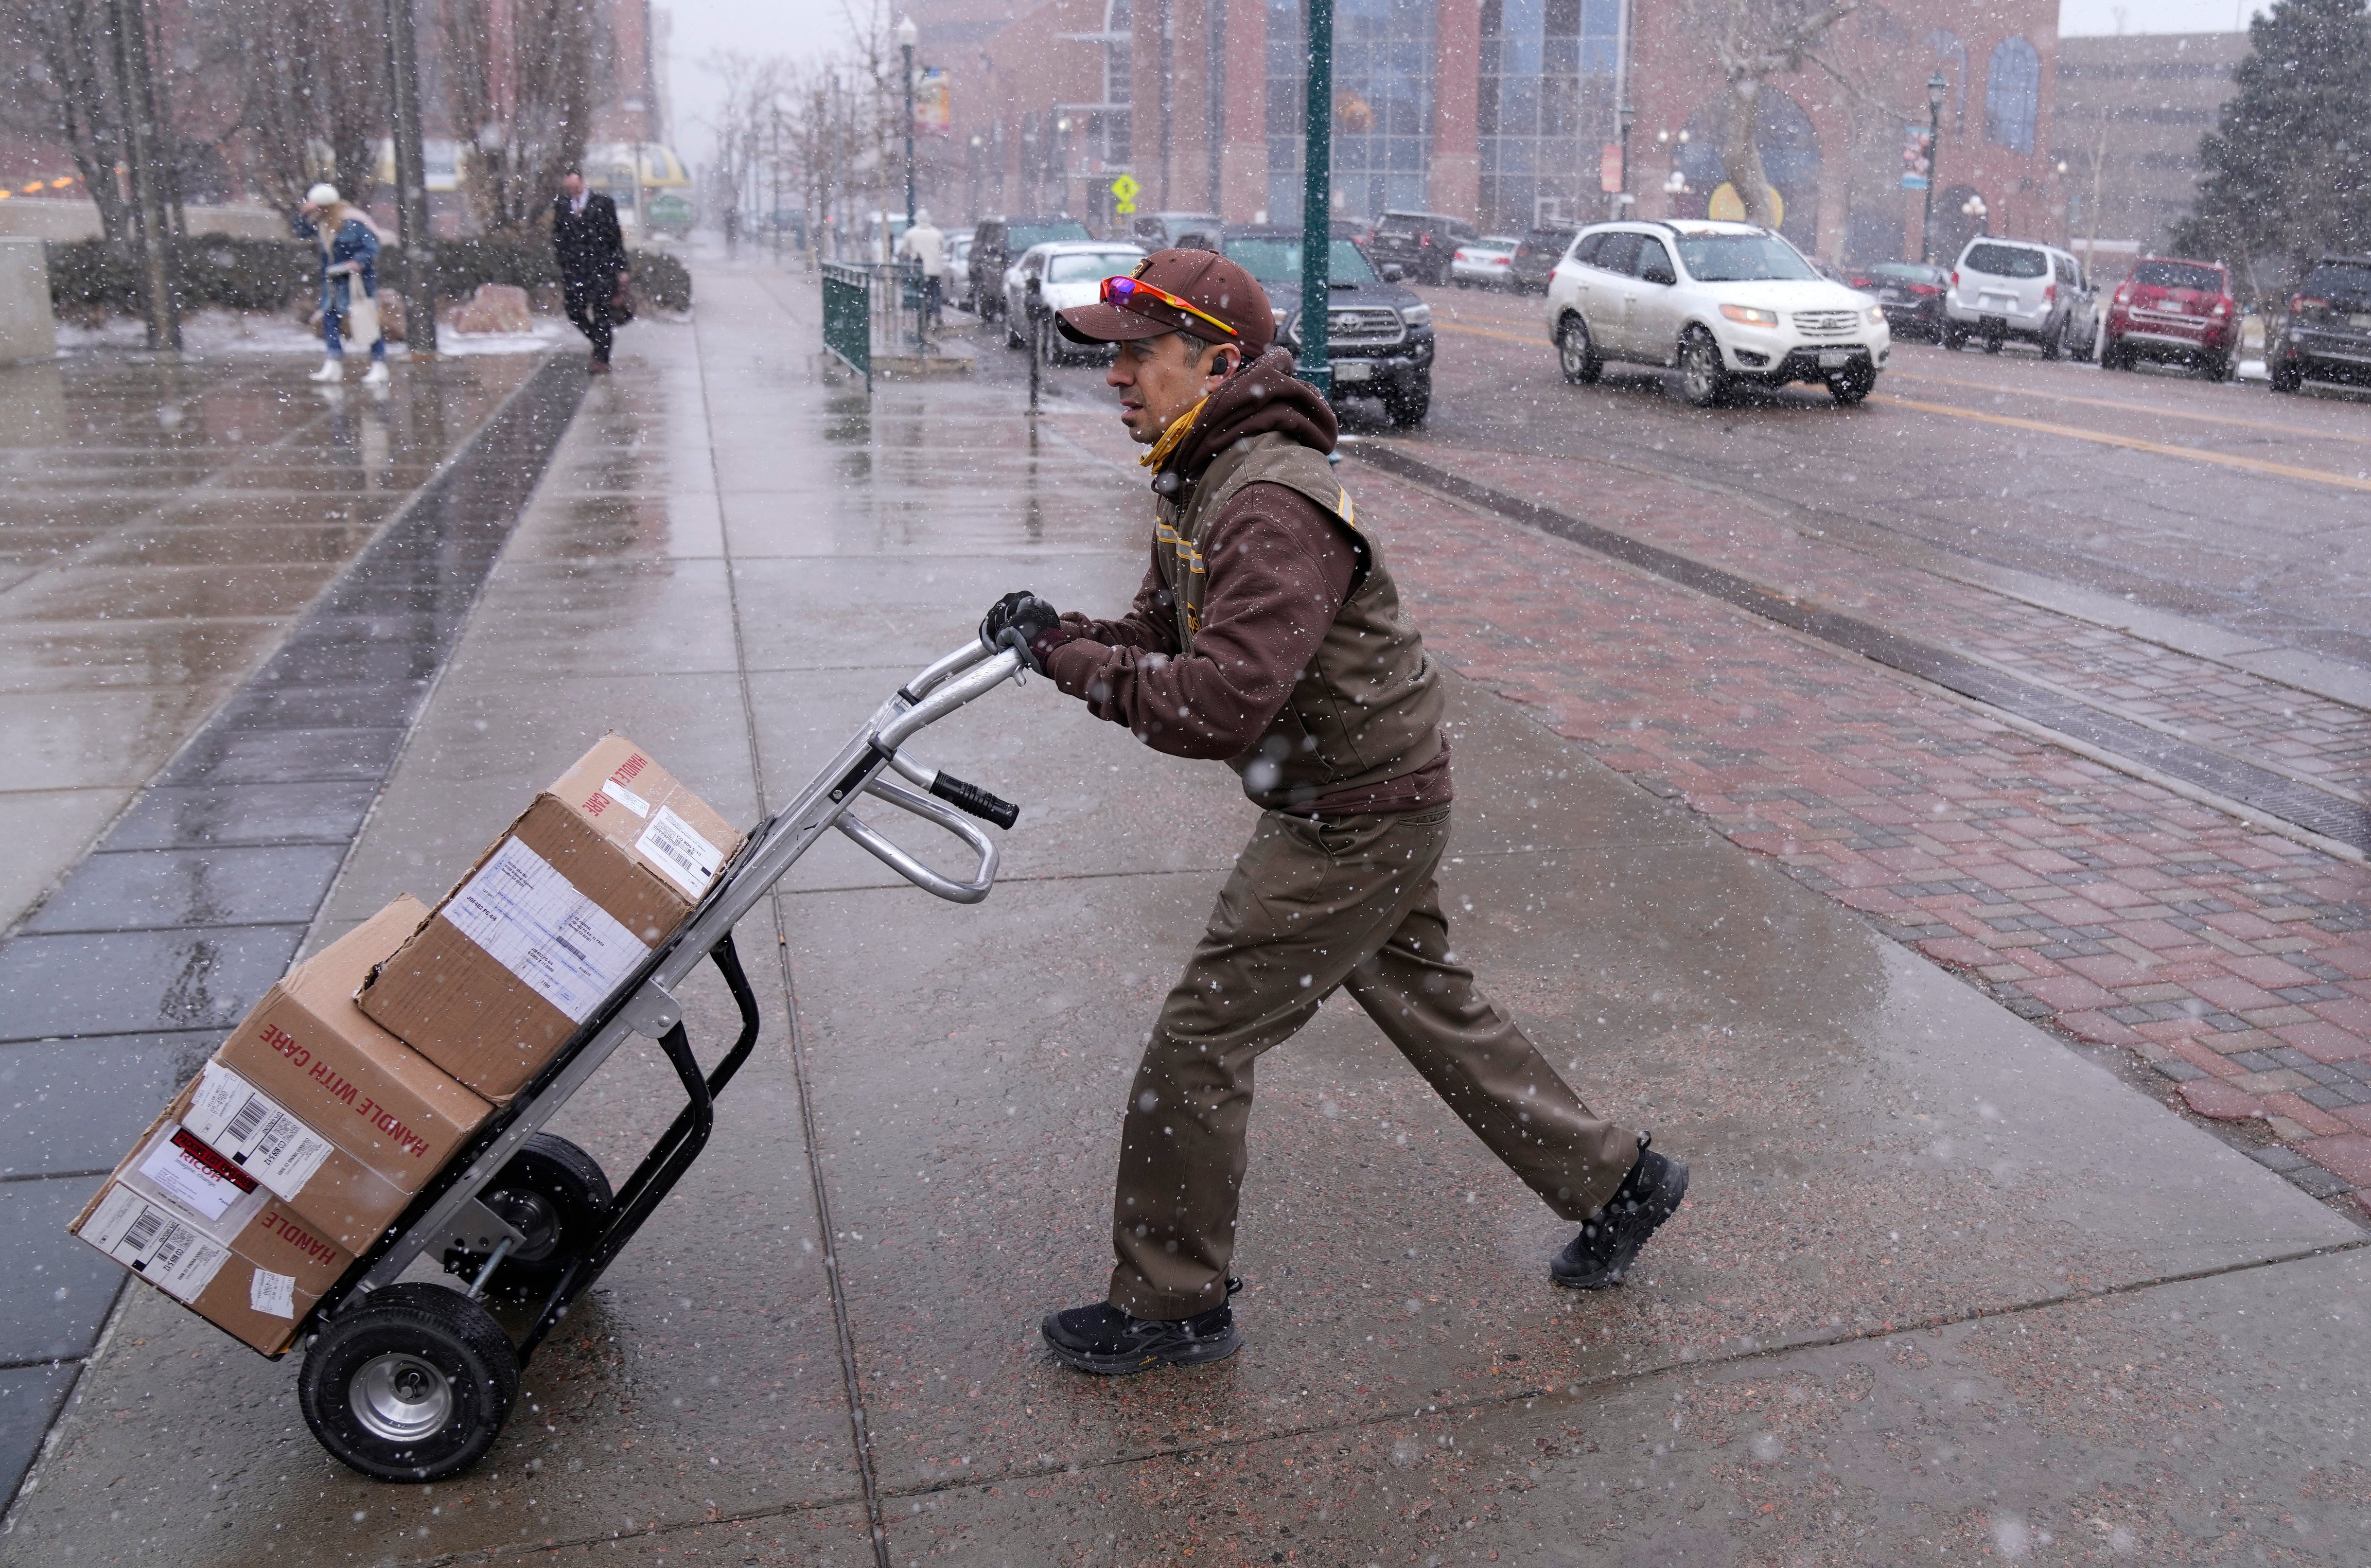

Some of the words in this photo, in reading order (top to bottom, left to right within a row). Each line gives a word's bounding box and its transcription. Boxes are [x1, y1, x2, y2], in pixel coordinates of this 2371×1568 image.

[614, 753, 648, 784] HANDLE
[582, 792, 611, 817] CARE
[660, 832, 677, 847] GROUND
[683, 840, 692, 849] 809
[691, 848, 701, 857] 5-12
[466, 895, 484, 910] JDF402
[482, 908, 490, 916] PG
[487, 912, 498, 922] 4/4
[578, 919, 591, 931] JUDICIAL
[540, 979, 551, 989] 1100
[260, 1024, 311, 1067] CARE
[309, 1062, 358, 1105] WITH
[210, 1090, 229, 1115] 87-4900
[273, 1111, 282, 1120] UPS
[261, 1117, 276, 1135] GROUND
[356, 1098, 430, 1158] HANDLE
[271, 1146, 281, 1157] 809
[277, 1140, 286, 1149] CO
[296, 1137, 309, 1153] COLORADO
[176, 1133, 207, 1158] PACKING
[204, 1152, 221, 1168] LIST
[219, 1162, 254, 1189] ENCLOSED
[264, 1153, 275, 1166] 5-12
[287, 1151, 298, 1164] SPRINGS
[174, 1157, 197, 1175] imagine.
[196, 1172, 218, 1189] change.
[179, 1150, 222, 1183] RICOH
[169, 1221, 177, 1230] UPS
[158, 1227, 172, 1243] GROUND
[262, 1212, 337, 1265] HANDLE
[169, 1254, 179, 1263] 809
[174, 1247, 183, 1256] CO
[163, 1260, 173, 1272] 5-12
[262, 1272, 274, 1296] 87-4900
